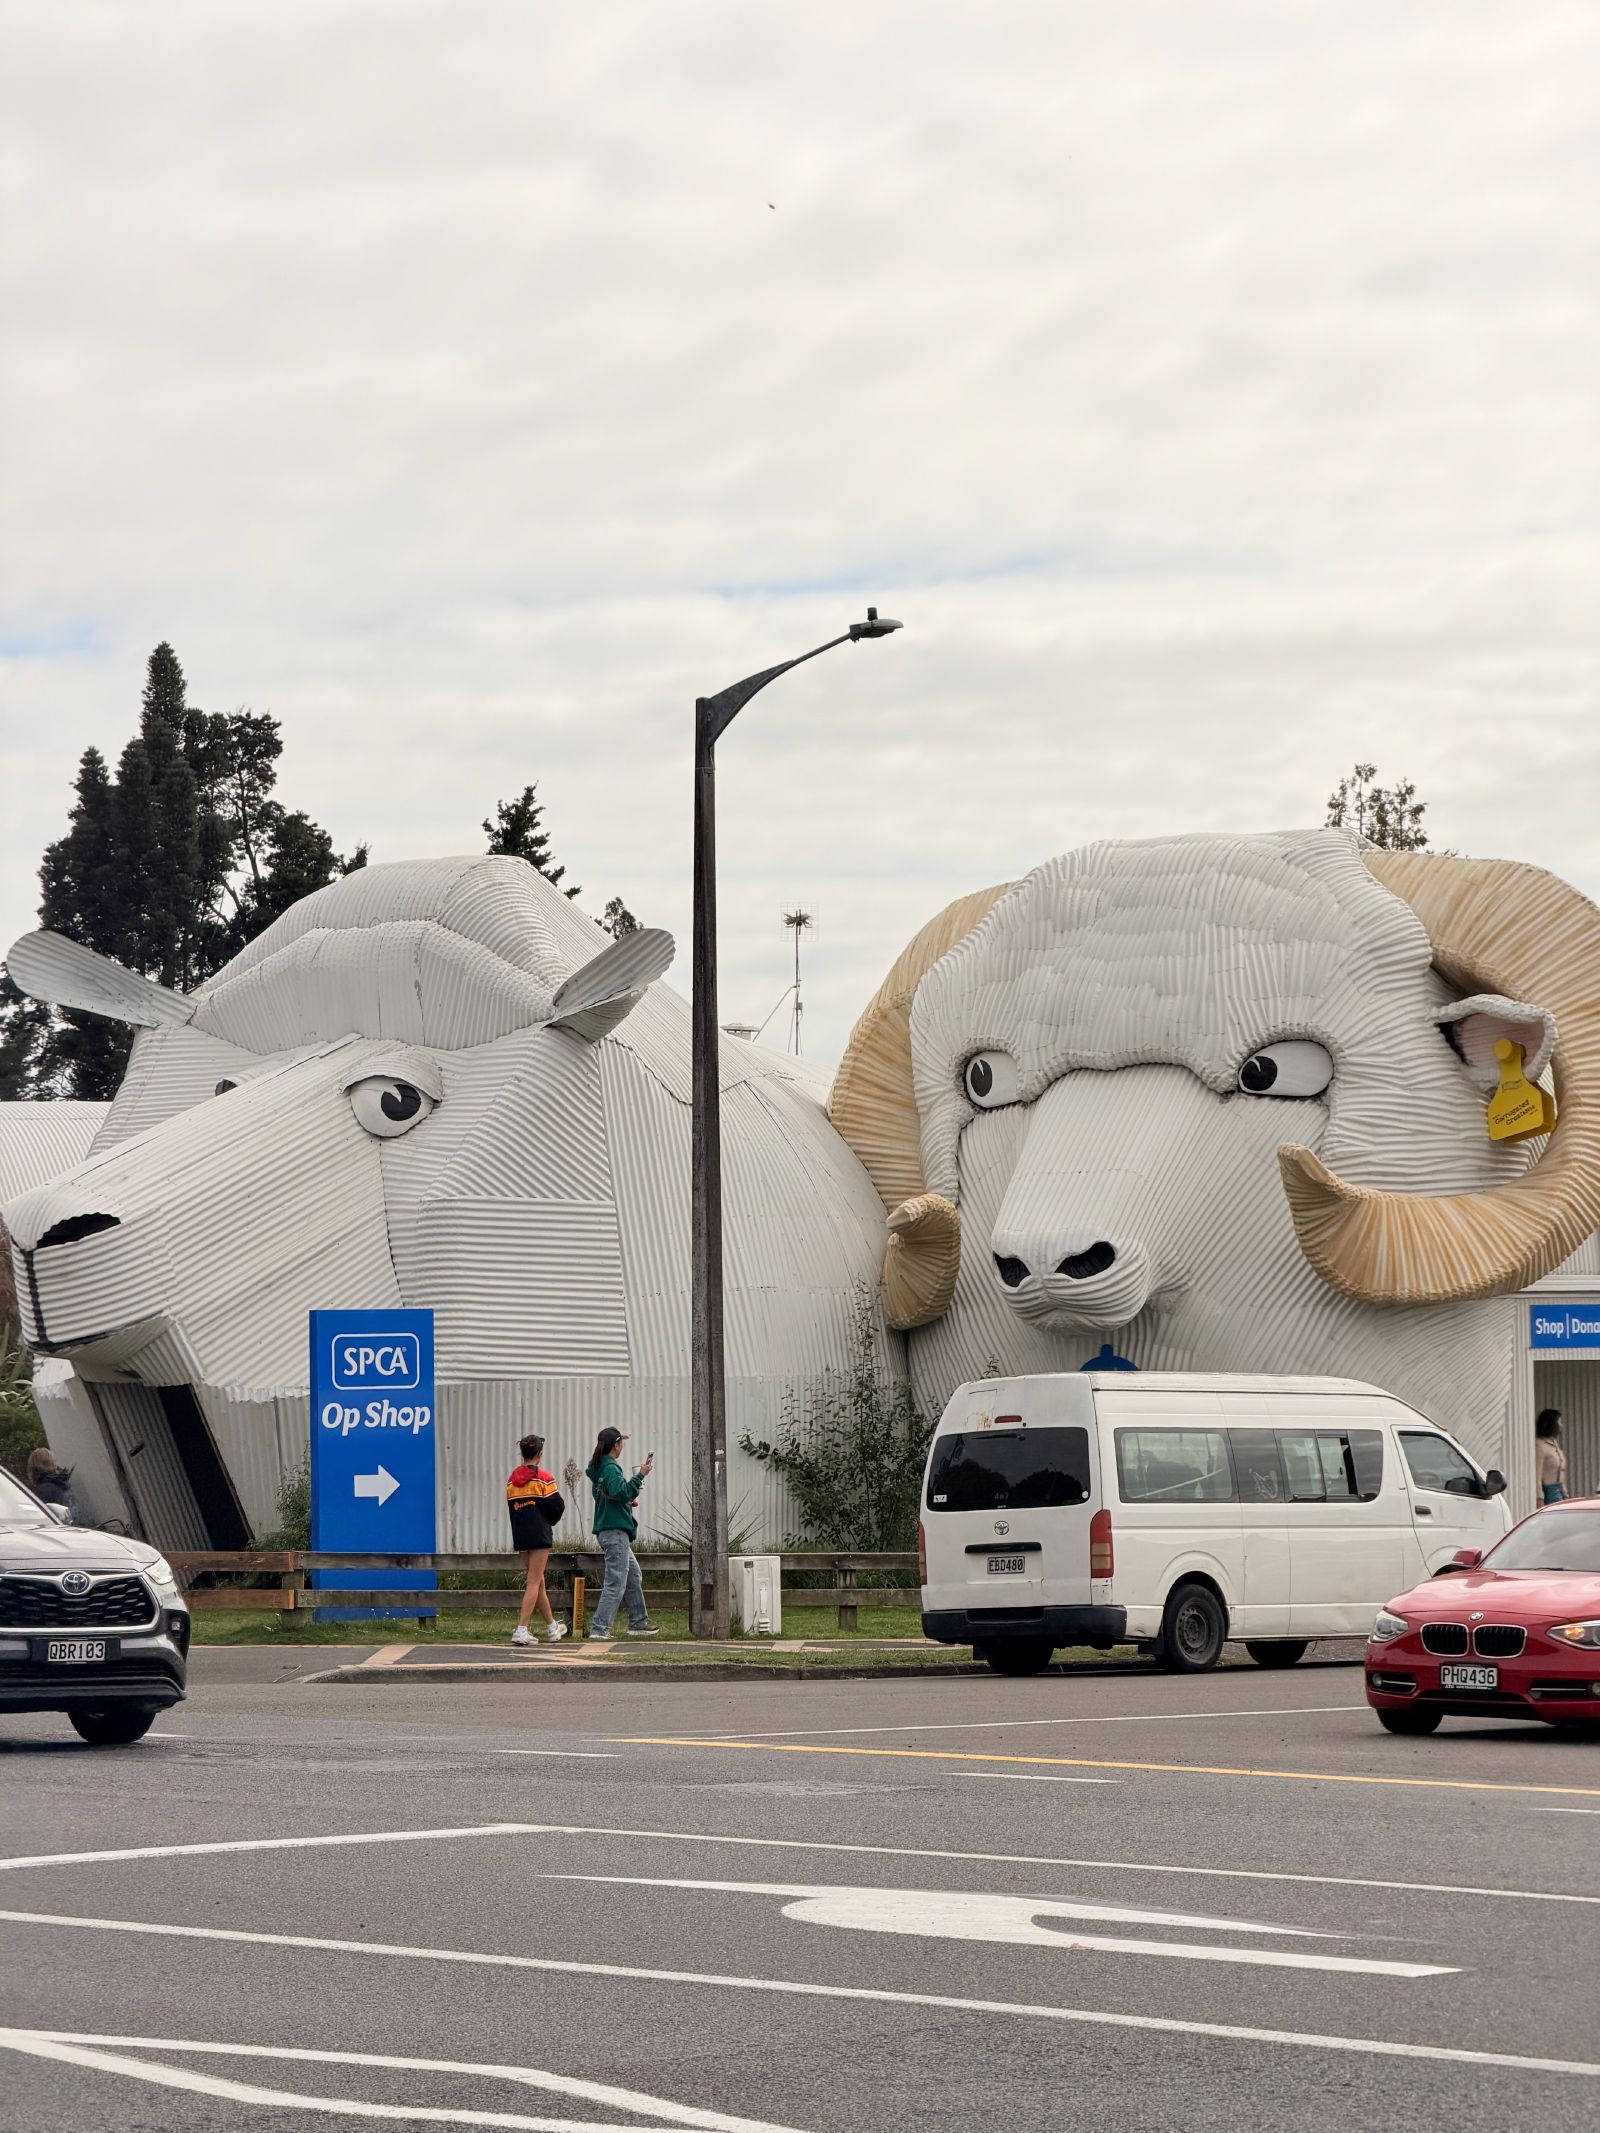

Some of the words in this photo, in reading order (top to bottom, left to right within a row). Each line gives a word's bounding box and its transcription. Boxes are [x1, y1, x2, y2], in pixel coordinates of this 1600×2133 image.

[1535, 1317, 1564, 1339] Shop
[343, 1346, 409, 1376] SPCA
[321, 1402, 361, 1437] Op
[364, 1399, 431, 1435] Shop
[988, 1559, 1024, 1572] EBD480
[49, 1642, 104, 1660] QBR103
[1442, 1667, 1495, 1685] PHQ436
